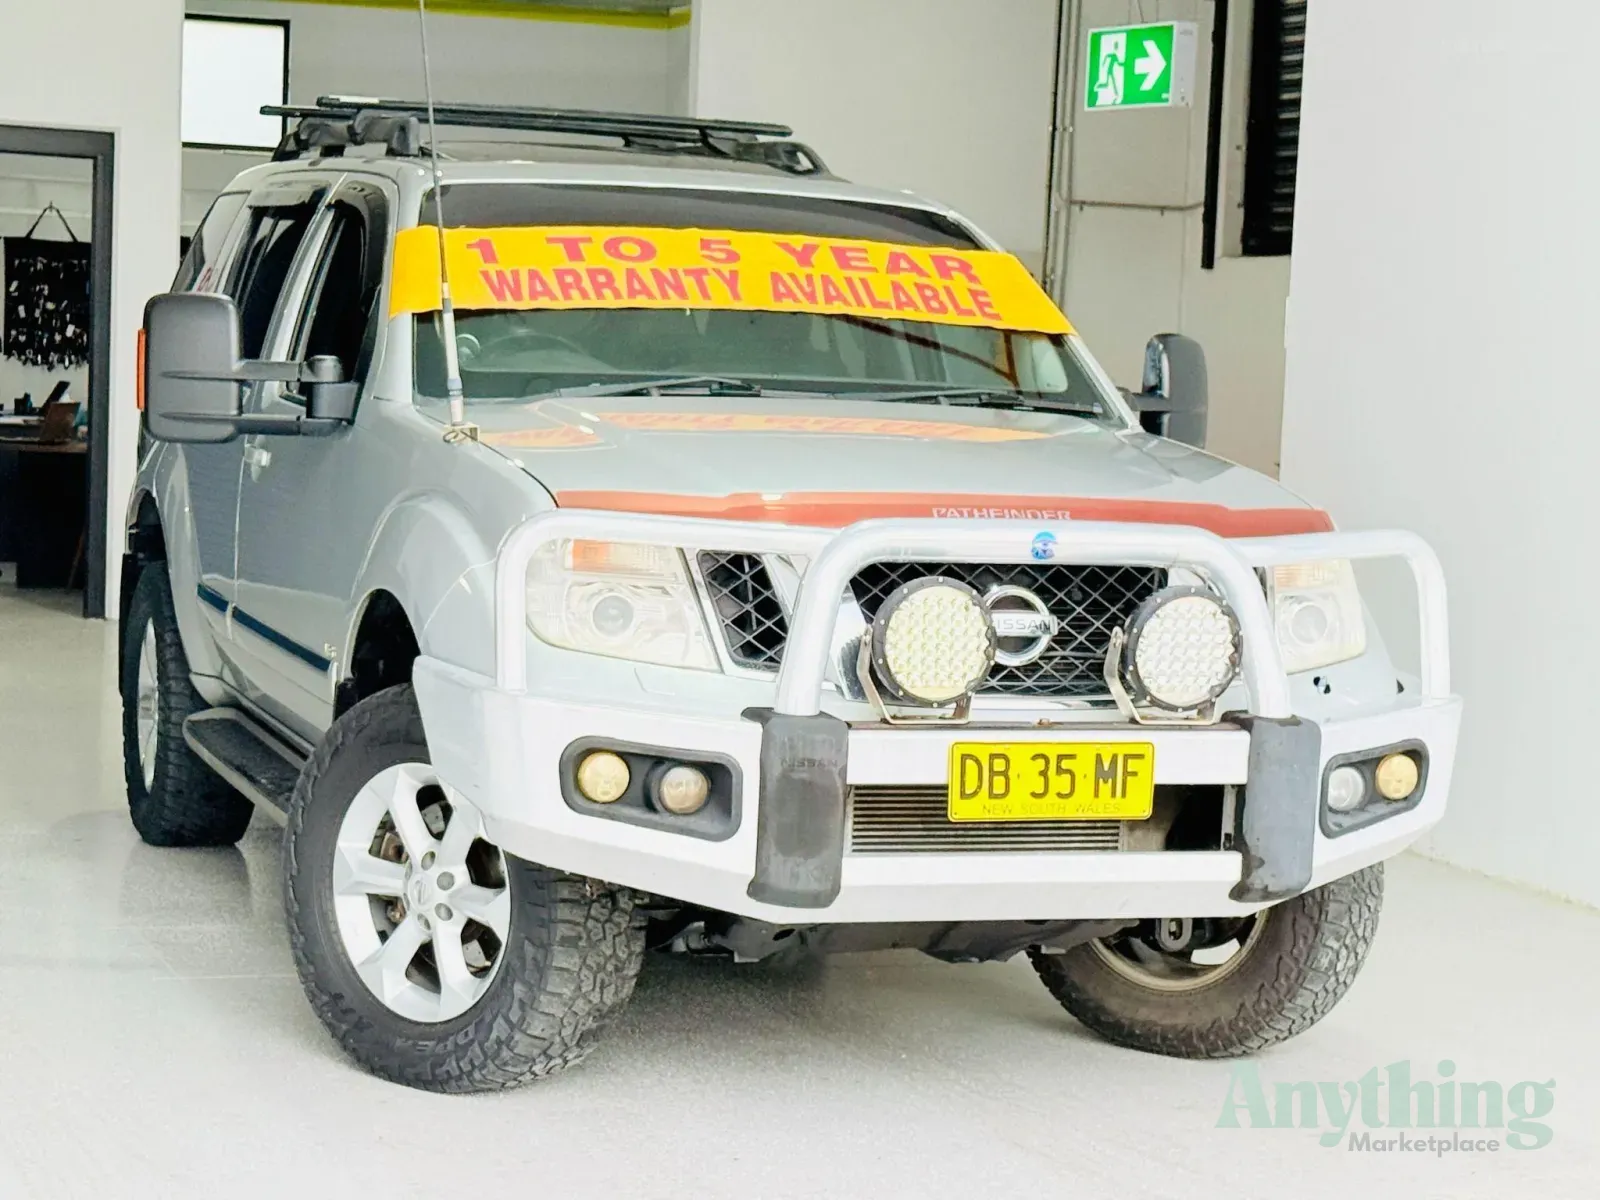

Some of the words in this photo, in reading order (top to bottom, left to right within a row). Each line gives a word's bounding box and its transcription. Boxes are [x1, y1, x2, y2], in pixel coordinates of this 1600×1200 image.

[466, 238, 499, 264] 1
[545, 236, 657, 263] TO
[700, 238, 741, 264] 5
[773, 241, 981, 284] YEAR
[479, 267, 742, 302] WARRANTY
[770, 271, 1003, 321] AVAILABLE
[931, 507, 1071, 521] PATHFINDER
[994, 618, 1051, 633] ISSAN
[982, 803, 1012, 815] NEW
[1021, 803, 1066, 814] SOUTH
[1076, 803, 1121, 813] WALES
